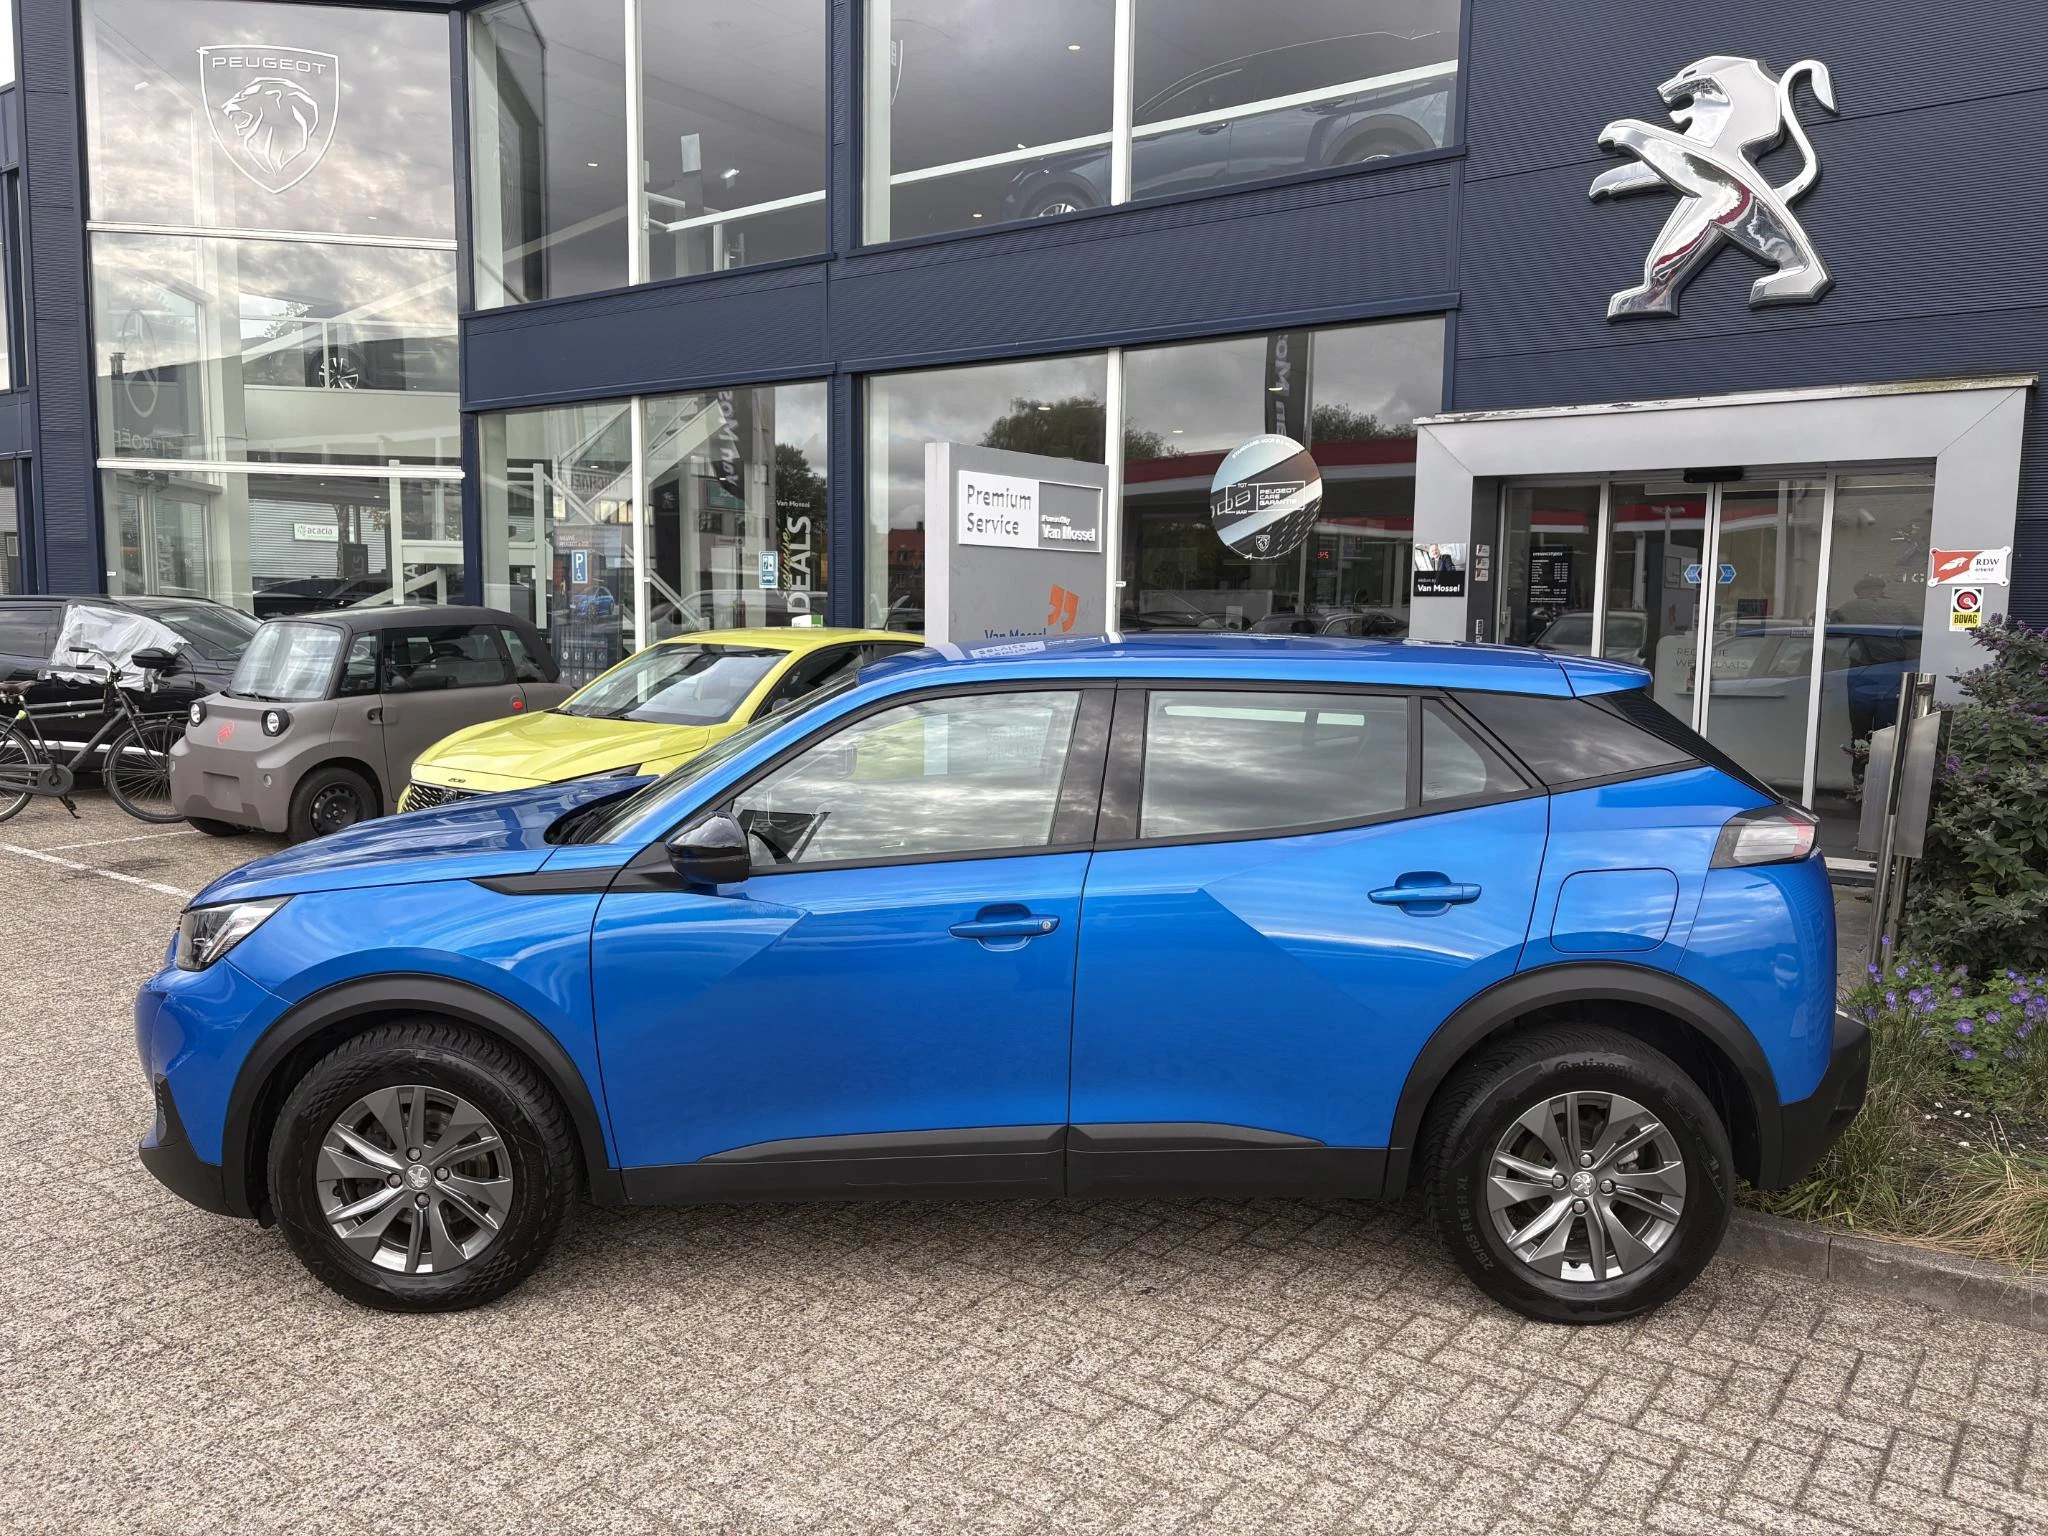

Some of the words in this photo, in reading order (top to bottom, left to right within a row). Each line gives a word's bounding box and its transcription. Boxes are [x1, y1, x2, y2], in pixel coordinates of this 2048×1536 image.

[212, 56, 327, 75] PEUGEOT
[776, 499, 789, 507] Van
[966, 484, 1032, 511] Premium
[966, 512, 1020, 536] Service
[307, 526, 333, 536] acacia
[1041, 523, 1061, 540] Van
[1062, 525, 1096, 542] Mossel
[576, 554, 584, 568] P
[786, 515, 812, 613] DEALS
[1975, 557, 2000, 567] RDW
[1417, 583, 1432, 593] Van
[1433, 583, 1460, 593] Mossel
[1953, 613, 1978, 625] BOVAG
[1676, 647, 1729, 657] RECTIE
[1676, 659, 1749, 670] WELAATS
[1456, 1194, 1468, 1205] H
[1457, 1207, 1470, 1222] 16
[1461, 1221, 1473, 1232] R
[1465, 1233, 1495, 1271] 215/65
